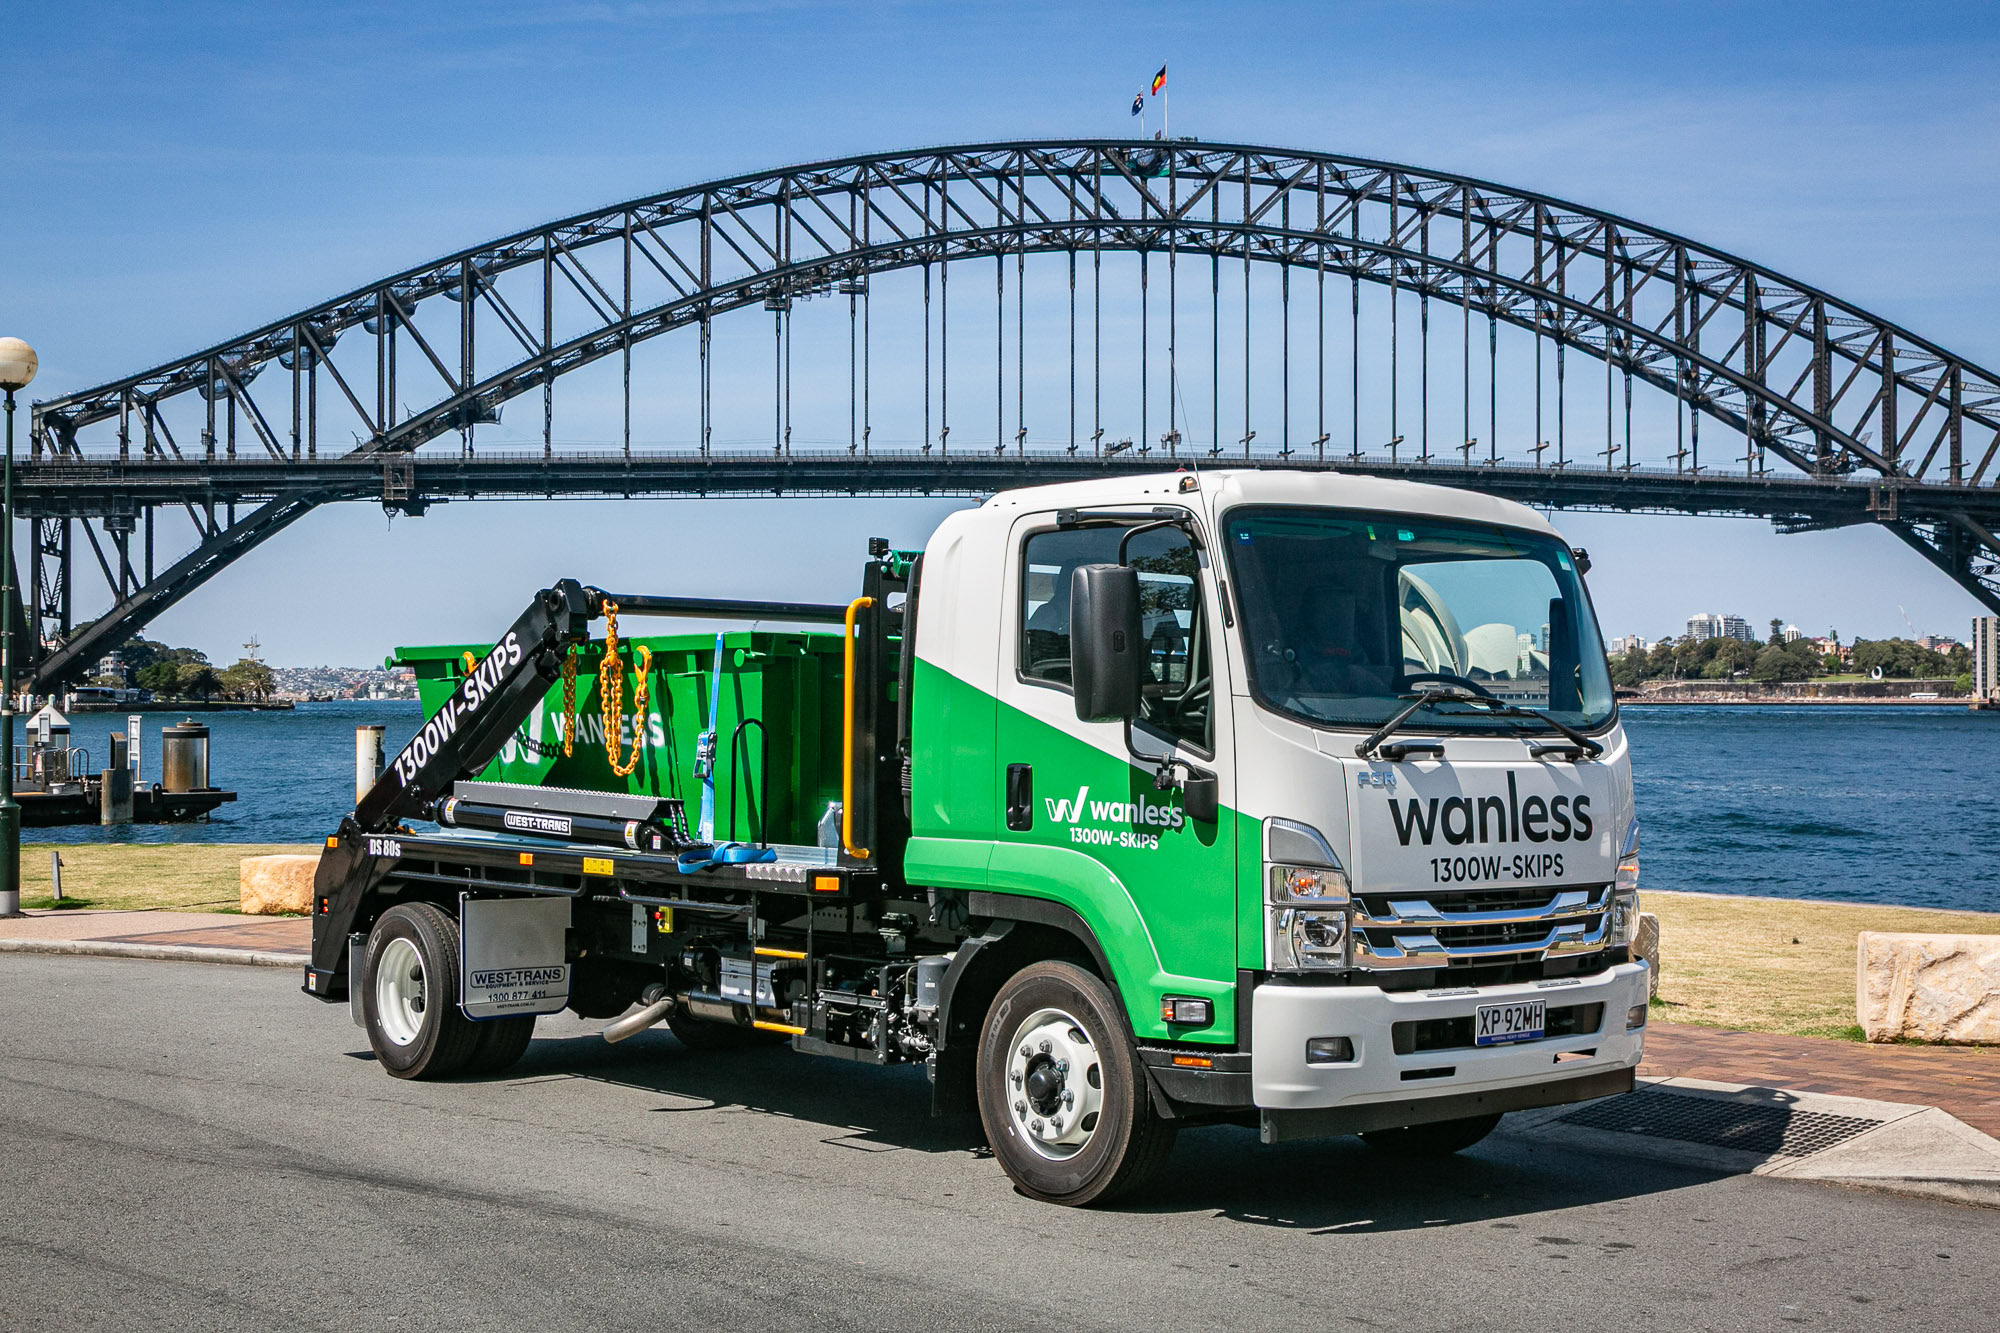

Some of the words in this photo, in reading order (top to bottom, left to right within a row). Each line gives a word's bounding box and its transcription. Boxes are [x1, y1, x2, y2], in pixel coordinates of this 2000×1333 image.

[394, 631, 521, 787] 1300W-SKIPS
[550, 711, 666, 747] WANESS
[1357, 771, 1397, 788] FSR
[1089, 794, 1183, 827] wanless
[1387, 770, 1594, 846] wanless
[507, 813, 569, 832] WEST-TRANS
[369, 838, 382, 856] DS
[383, 839, 401, 857] 80s
[1069, 827, 1159, 850] 1300W-SKIPS
[1430, 853, 1564, 883] 1300W-SKIPS
[475, 969, 561, 985] WEST-TRANS
[488, 992, 509, 1002] 1300
[512, 991, 528, 1000] 877
[531, 990, 546, 999] 411
